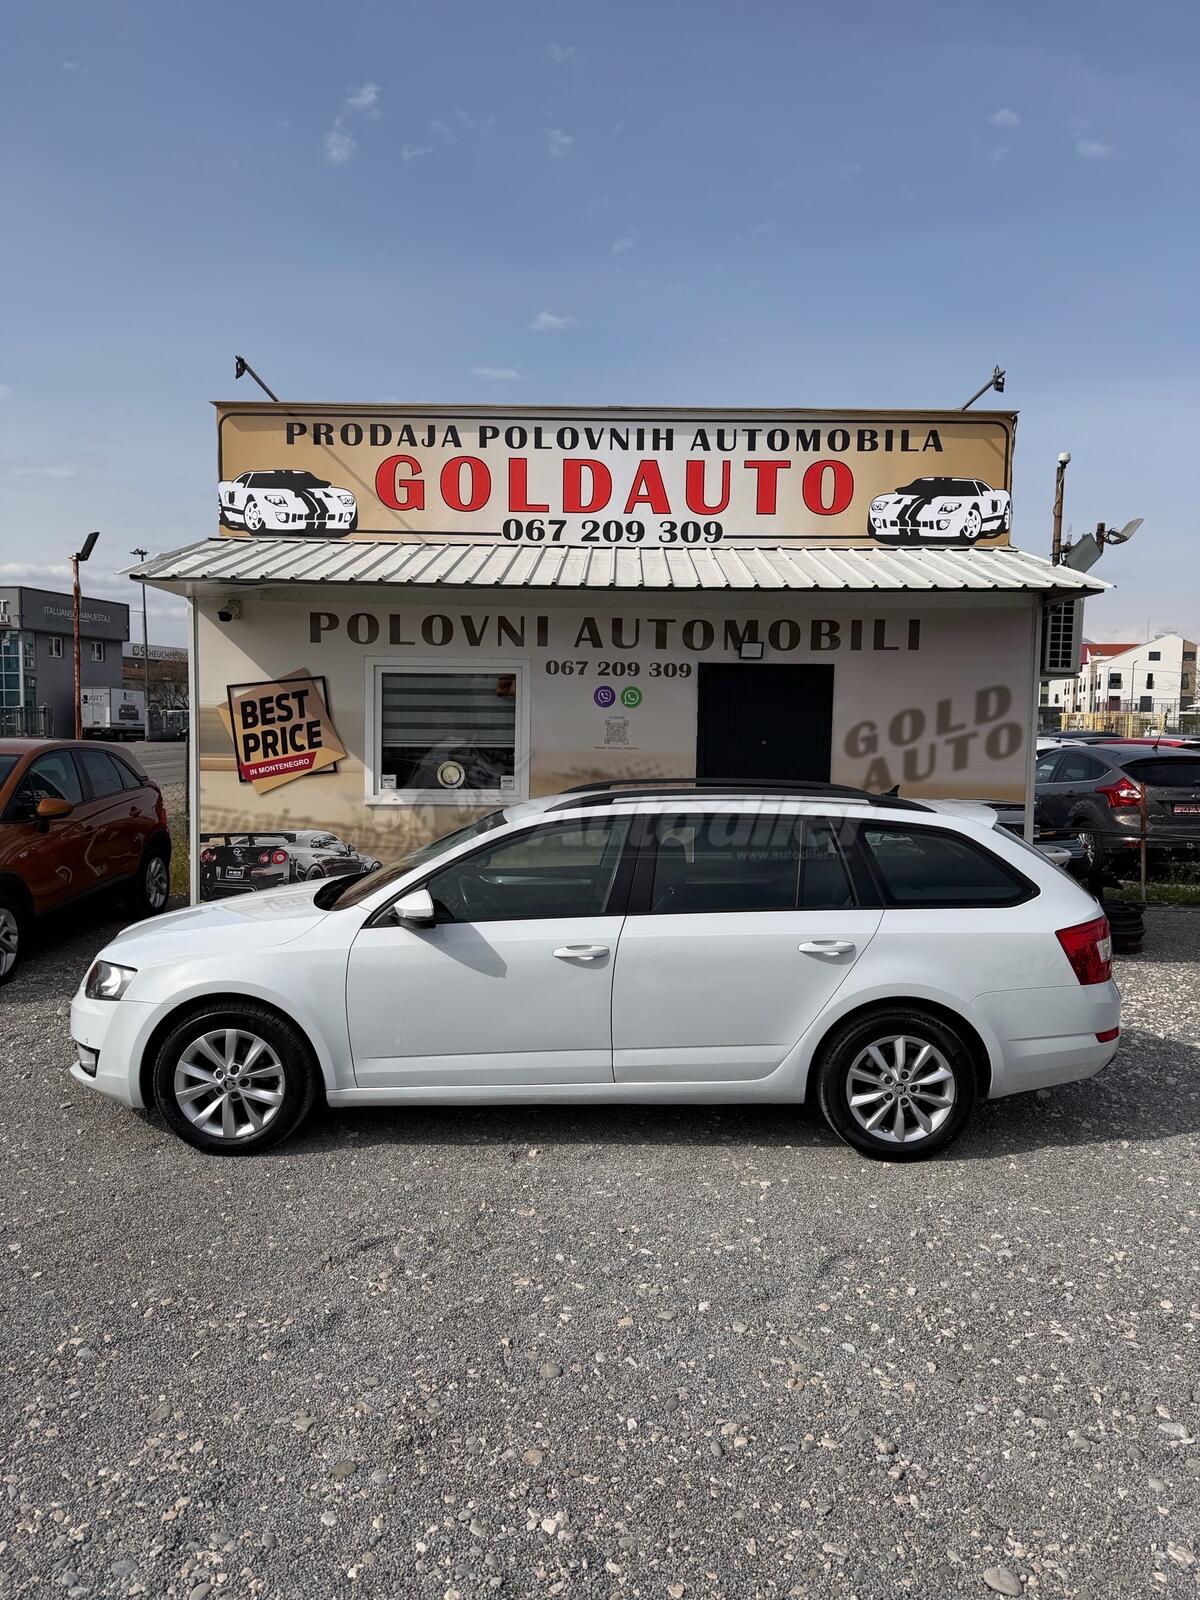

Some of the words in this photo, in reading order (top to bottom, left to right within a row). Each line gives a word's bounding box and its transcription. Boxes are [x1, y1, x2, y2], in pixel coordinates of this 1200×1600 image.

[286, 422, 462, 448] PRODAJA
[479, 425, 675, 451] POLOVNIH
[690, 427, 943, 452] AUTOMOBILA
[375, 454, 855, 516] GOLDAUTO
[501, 519, 567, 542] 067
[581, 519, 645, 543] 209
[658, 519, 724, 544] 309
[309, 611, 549, 648] POLOVNI
[574, 615, 921, 652] AUTOMOBILI
[545, 659, 588, 676] 067
[597, 660, 640, 678] 209
[648, 661, 692, 678] 309
[240, 688, 309, 730] BEST
[844, 684, 1012, 760] GOLD
[242, 719, 323, 763] PRICE
[863, 720, 1023, 790] AUTO
[249, 767, 258, 776] IN
[258, 757, 310, 775] MONTENEGRO
